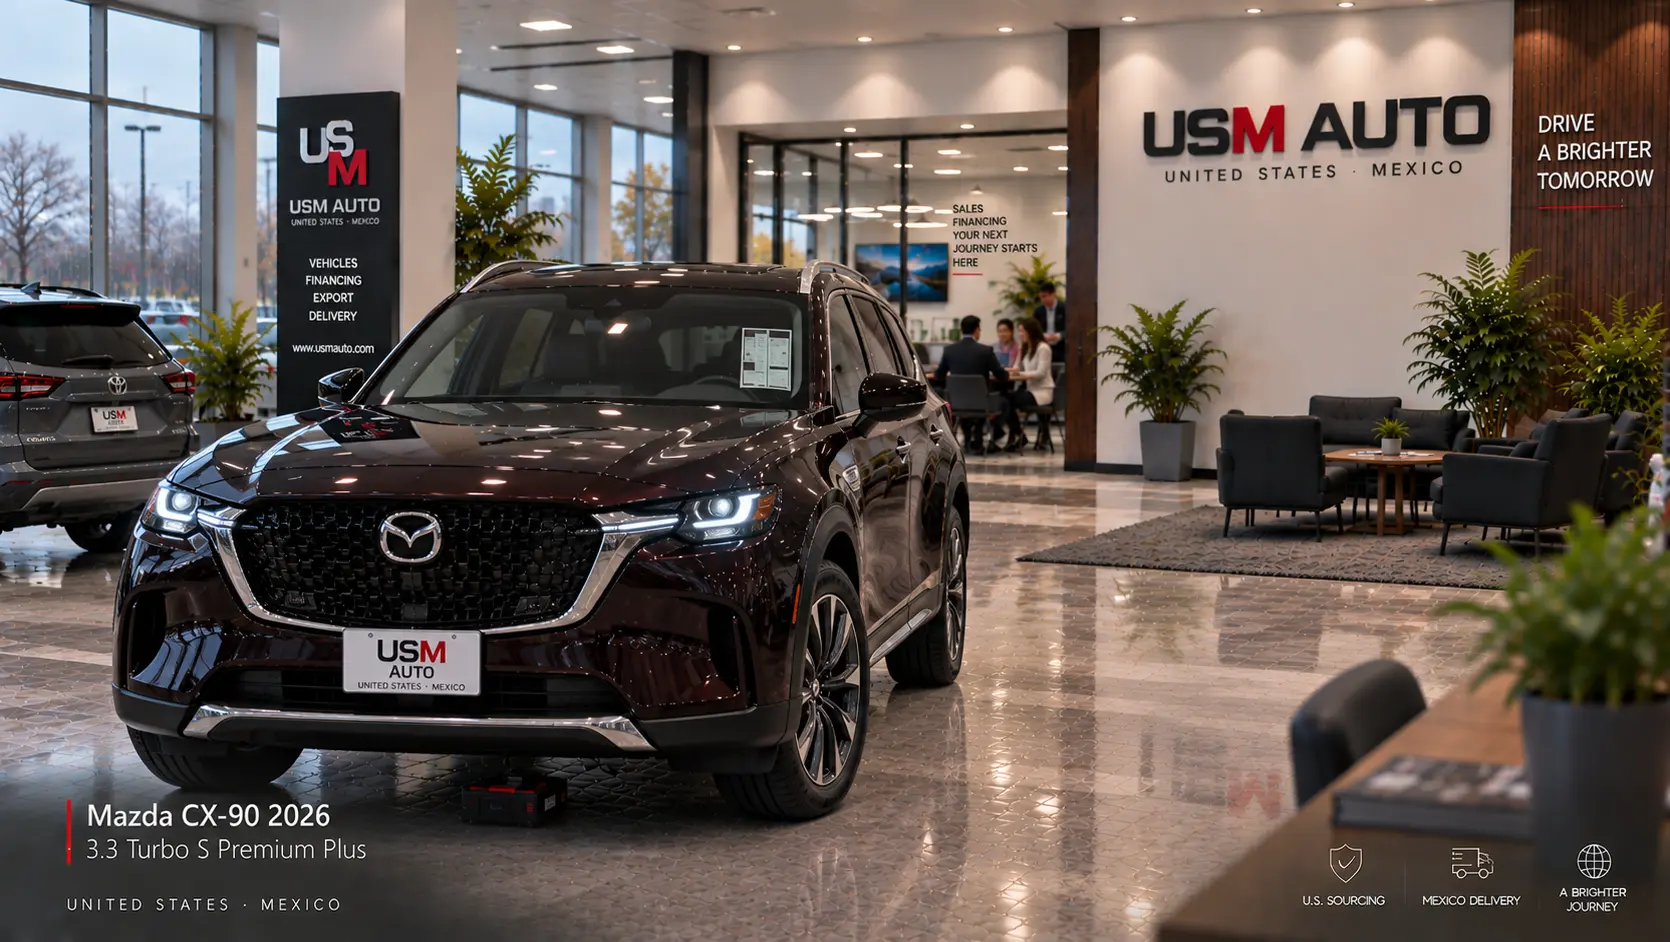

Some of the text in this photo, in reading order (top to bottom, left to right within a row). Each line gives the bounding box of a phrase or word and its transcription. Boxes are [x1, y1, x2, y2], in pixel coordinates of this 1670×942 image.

[1143, 94, 1492, 159] USM AUTO
[1538, 113, 1595, 134] DRIVE
[1537, 140, 1652, 161] A BRIGHTER
[1165, 160, 1463, 184] UNITED STATES MEXICO
[1536, 168, 1655, 190] TOMORROW
[289, 197, 381, 215] USM AUTO
[952, 203, 984, 214] SALES
[290, 218, 318, 227] UNITED
[319, 217, 344, 226] STATES
[952, 216, 1007, 227] FINANCING
[952, 229, 1009, 240] YOUR NEXT
[952, 243, 1038, 254] JOURNEY STARTS
[308, 257, 358, 269] VEHICLES
[952, 257, 979, 268] HERE
[305, 275, 362, 286] FINANCING
[313, 292, 354, 303] EXPORT
[309, 310, 358, 322] DELIVERY
[292, 343, 375, 354] www.usmauto.com
[102, 409, 127, 421] USM
[377, 639, 446, 664] USM
[388, 664, 435, 679] AUTO
[357, 681, 466, 692] UNITED STATES MEXICO
